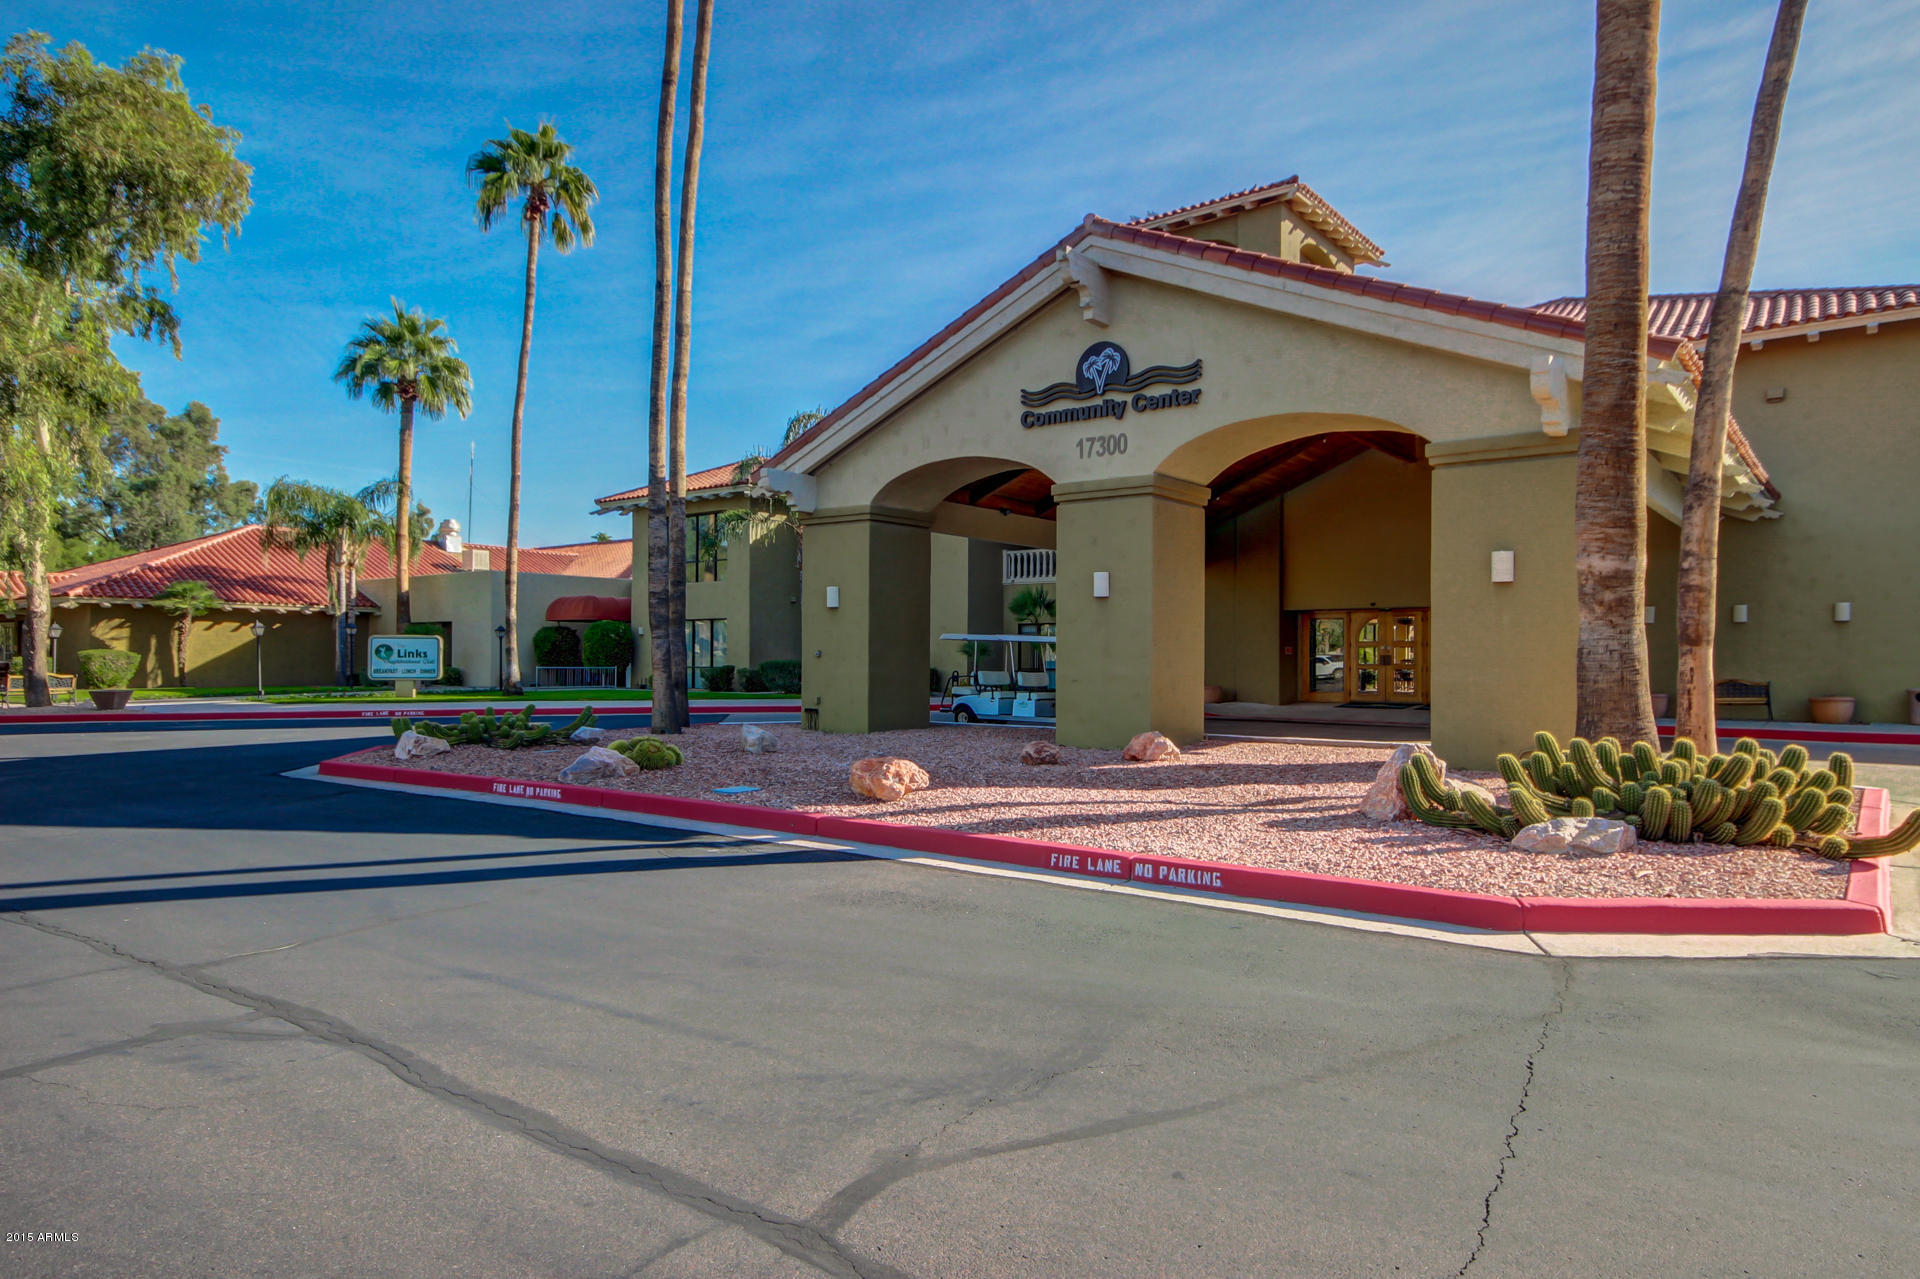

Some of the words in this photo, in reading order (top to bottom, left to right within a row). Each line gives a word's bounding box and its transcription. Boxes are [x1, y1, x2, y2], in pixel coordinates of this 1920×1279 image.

[1020, 398, 1128, 429] Community
[1131, 387, 1202, 413] Center
[1075, 432, 1128, 459] 17300
[397, 648, 428, 658] Links
[493, 782, 507, 793] FIRE
[509, 784, 525, 794] LANE
[535, 787, 562, 799] PARKING
[1050, 853, 1080, 869] FIRE
[1087, 857, 1121, 874] LANE
[1134, 862, 1153, 878] NO
[1159, 865, 1223, 887] PARKING
